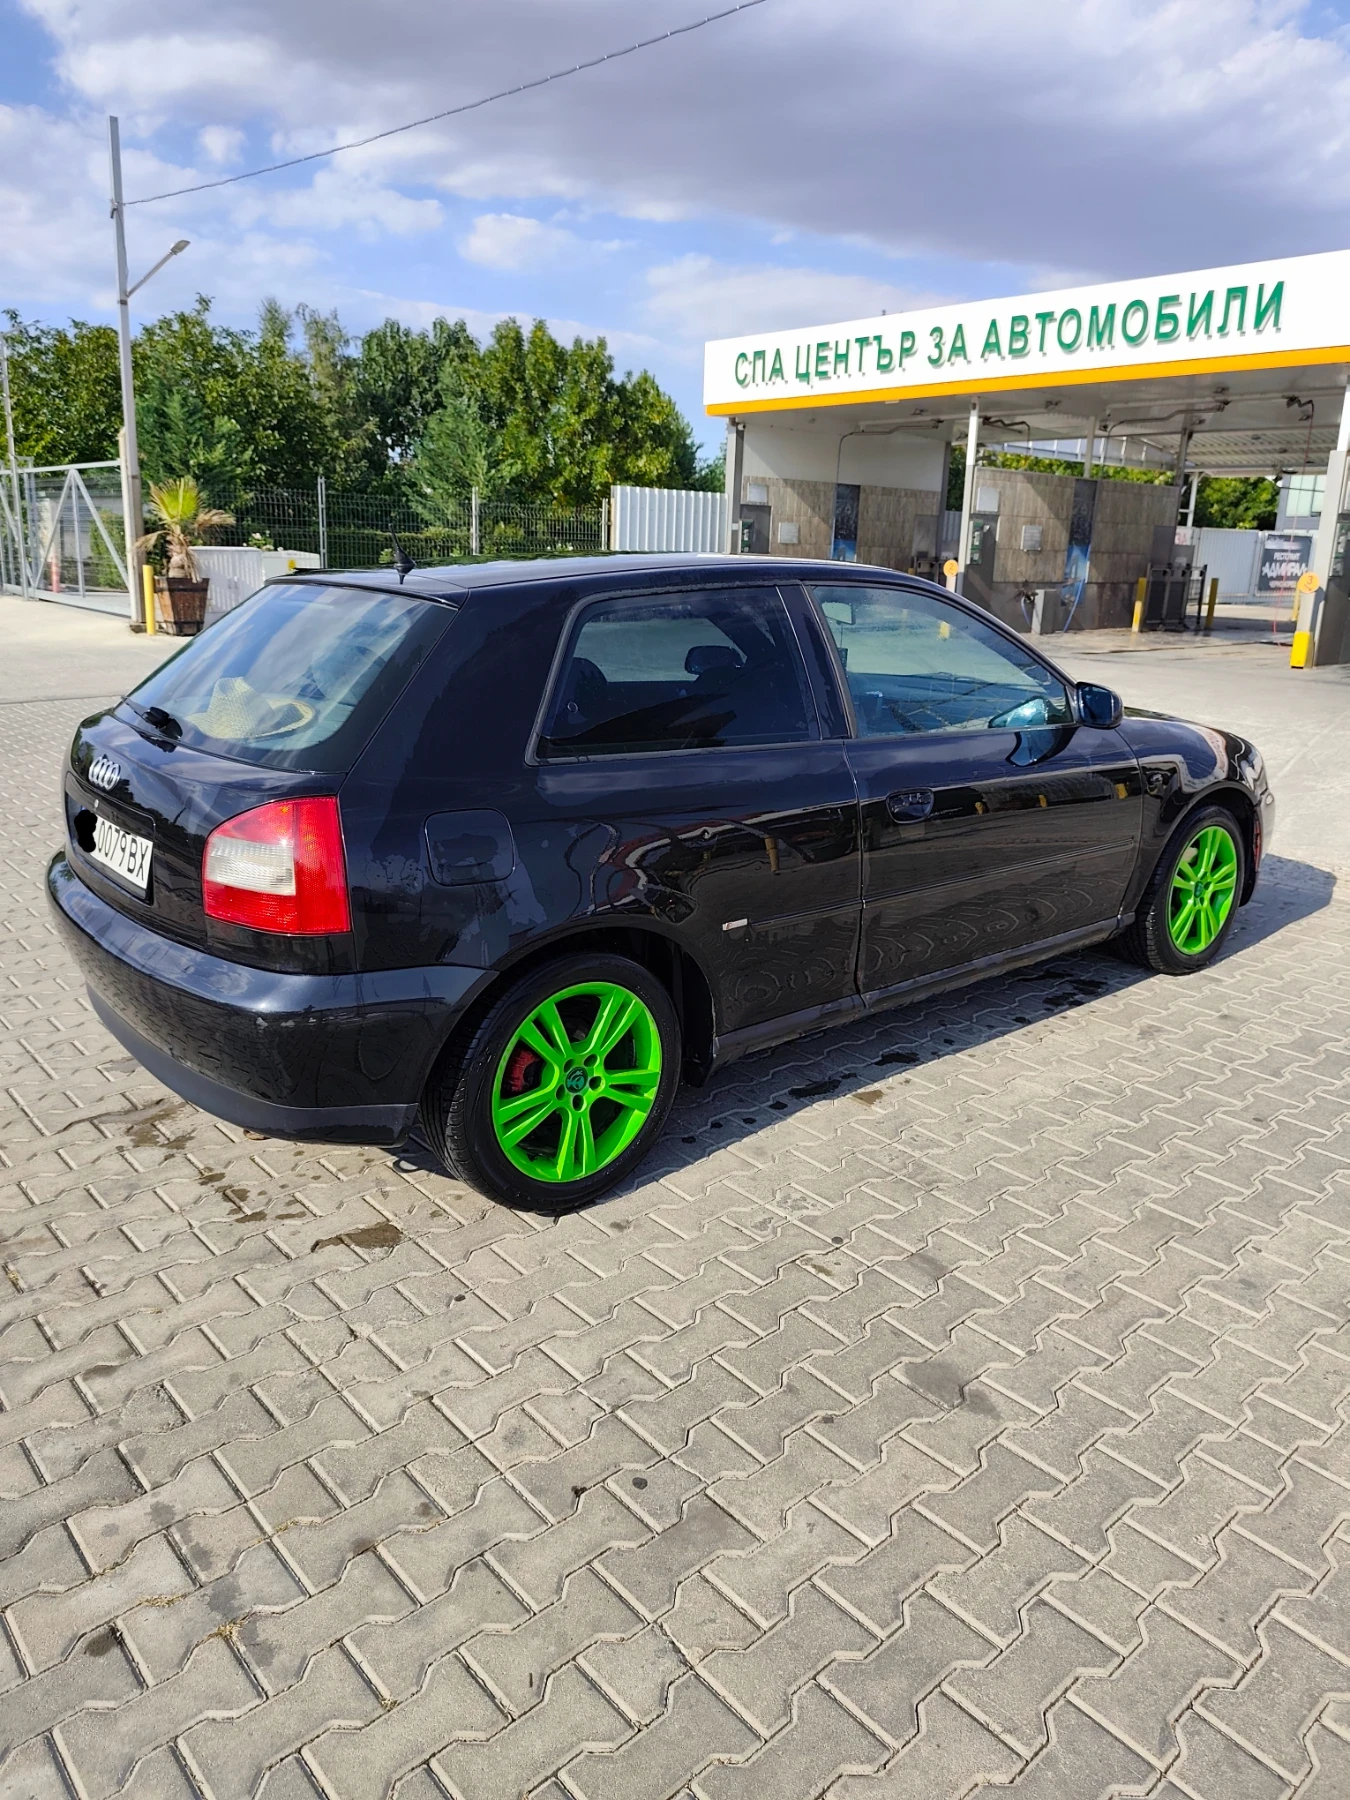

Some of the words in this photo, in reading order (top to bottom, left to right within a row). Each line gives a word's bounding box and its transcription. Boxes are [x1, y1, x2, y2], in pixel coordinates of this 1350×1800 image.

[734, 348, 786, 387] СПА
[795, 331, 917, 386] ЦЕНТЪР
[927, 323, 969, 366] ЗА
[980, 281, 1285, 359] АВТОМОБИЛИ
[1306, 575, 1314, 585] 3
